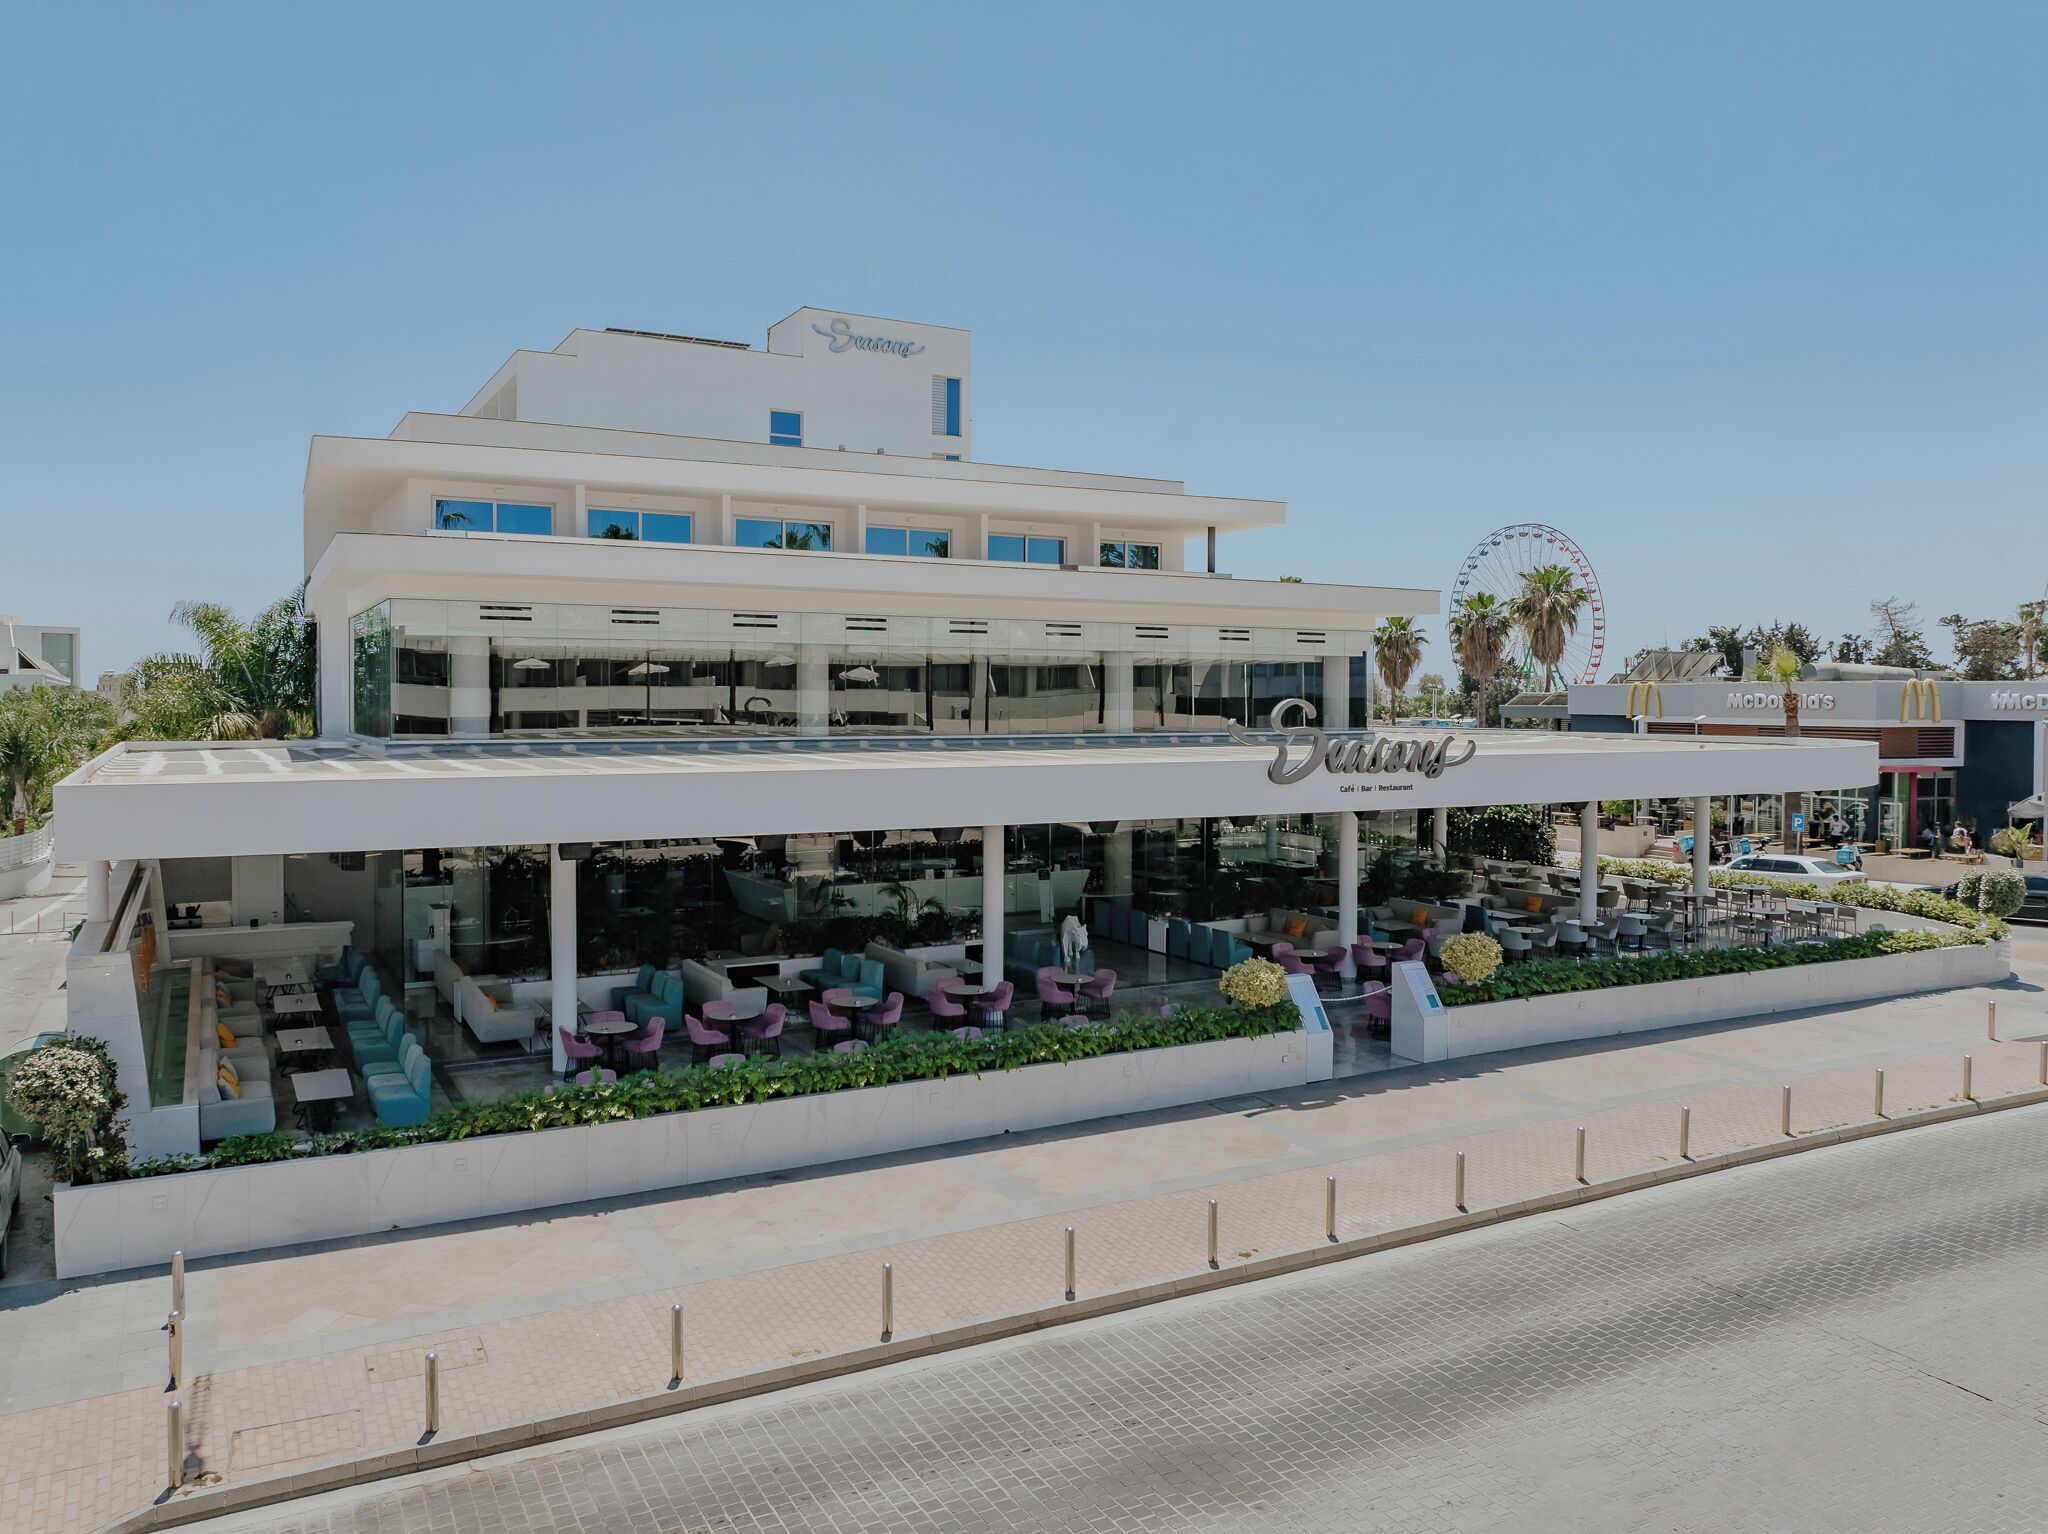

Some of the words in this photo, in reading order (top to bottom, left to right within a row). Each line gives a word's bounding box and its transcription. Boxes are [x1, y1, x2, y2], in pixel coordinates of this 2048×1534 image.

[811, 318, 925, 359] Seasons
[1726, 692, 1835, 711] McDold's
[1227, 698, 1476, 785] Seasons
[1339, 784, 1355, 793] Café
[1378, 783, 1414, 792] Restaurant
[1794, 817, 1803, 828] P
